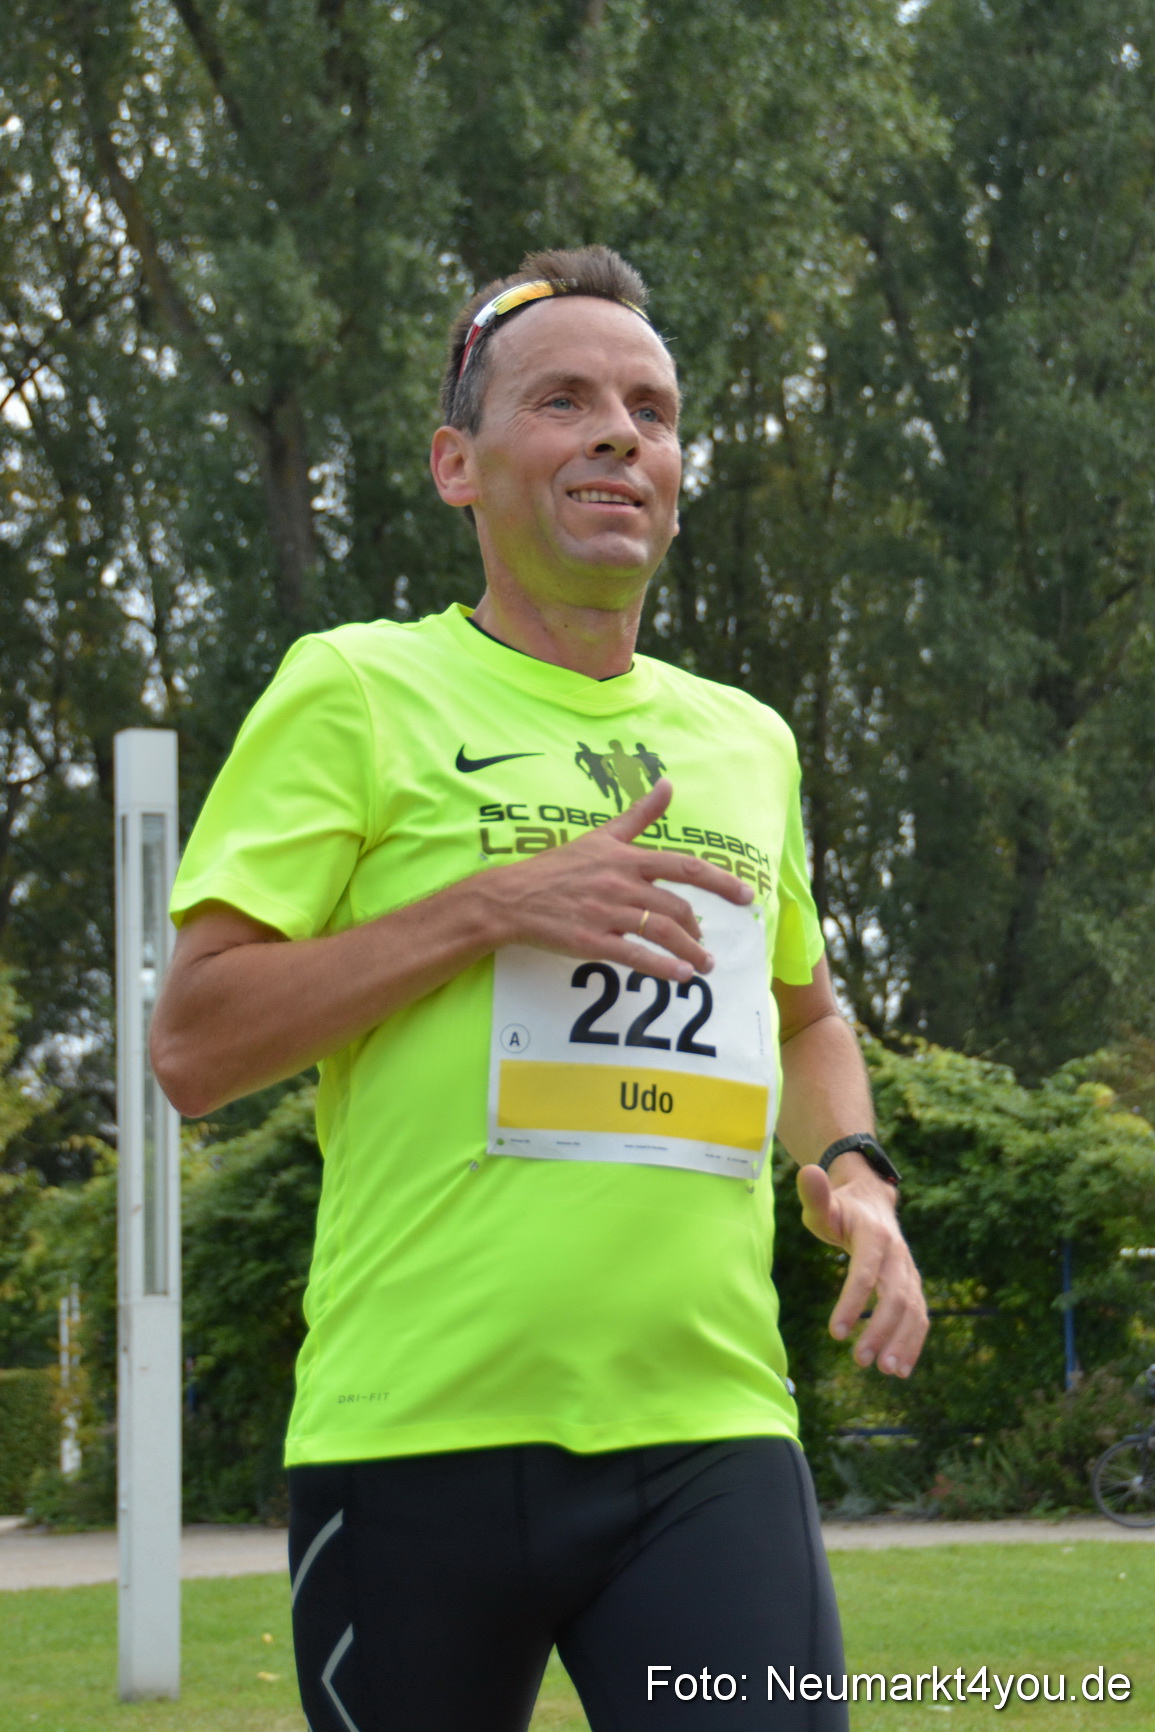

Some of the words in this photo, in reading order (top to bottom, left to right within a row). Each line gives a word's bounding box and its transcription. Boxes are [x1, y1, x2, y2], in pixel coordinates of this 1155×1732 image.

[479, 803, 530, 822] SC
[569, 962, 717, 1058] 222
[509, 1031, 520, 1046] A
[620, 1081, 674, 1114] Udo
[337, 1392, 390, 1404] DRI-FIT
